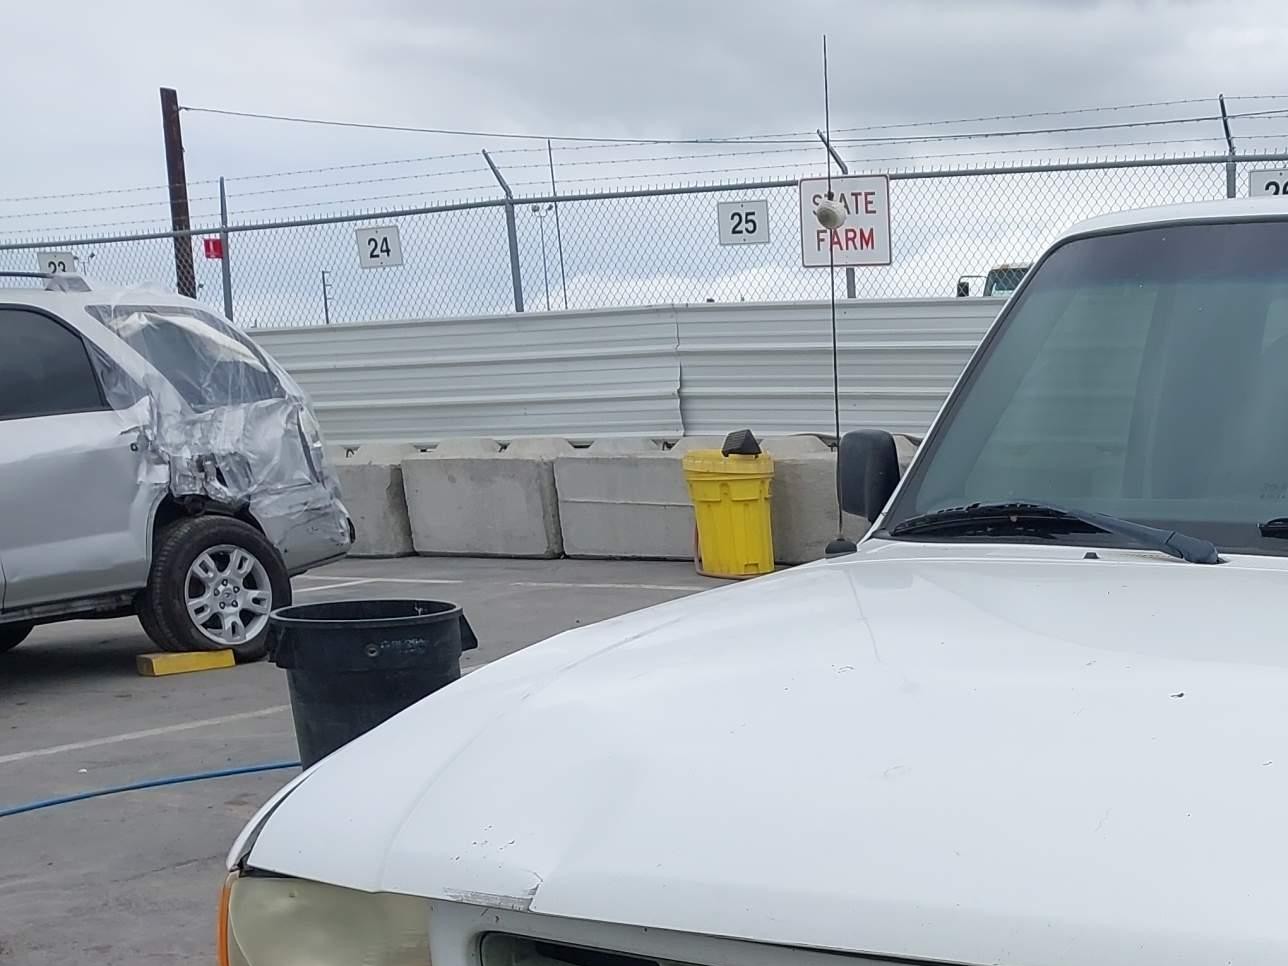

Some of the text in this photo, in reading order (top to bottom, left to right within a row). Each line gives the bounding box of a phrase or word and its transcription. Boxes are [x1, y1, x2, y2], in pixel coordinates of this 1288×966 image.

[812, 191, 876, 216] SATE
[730, 211, 757, 234] 25
[367, 236, 391, 259] 24
[816, 227, 875, 251] FARM
